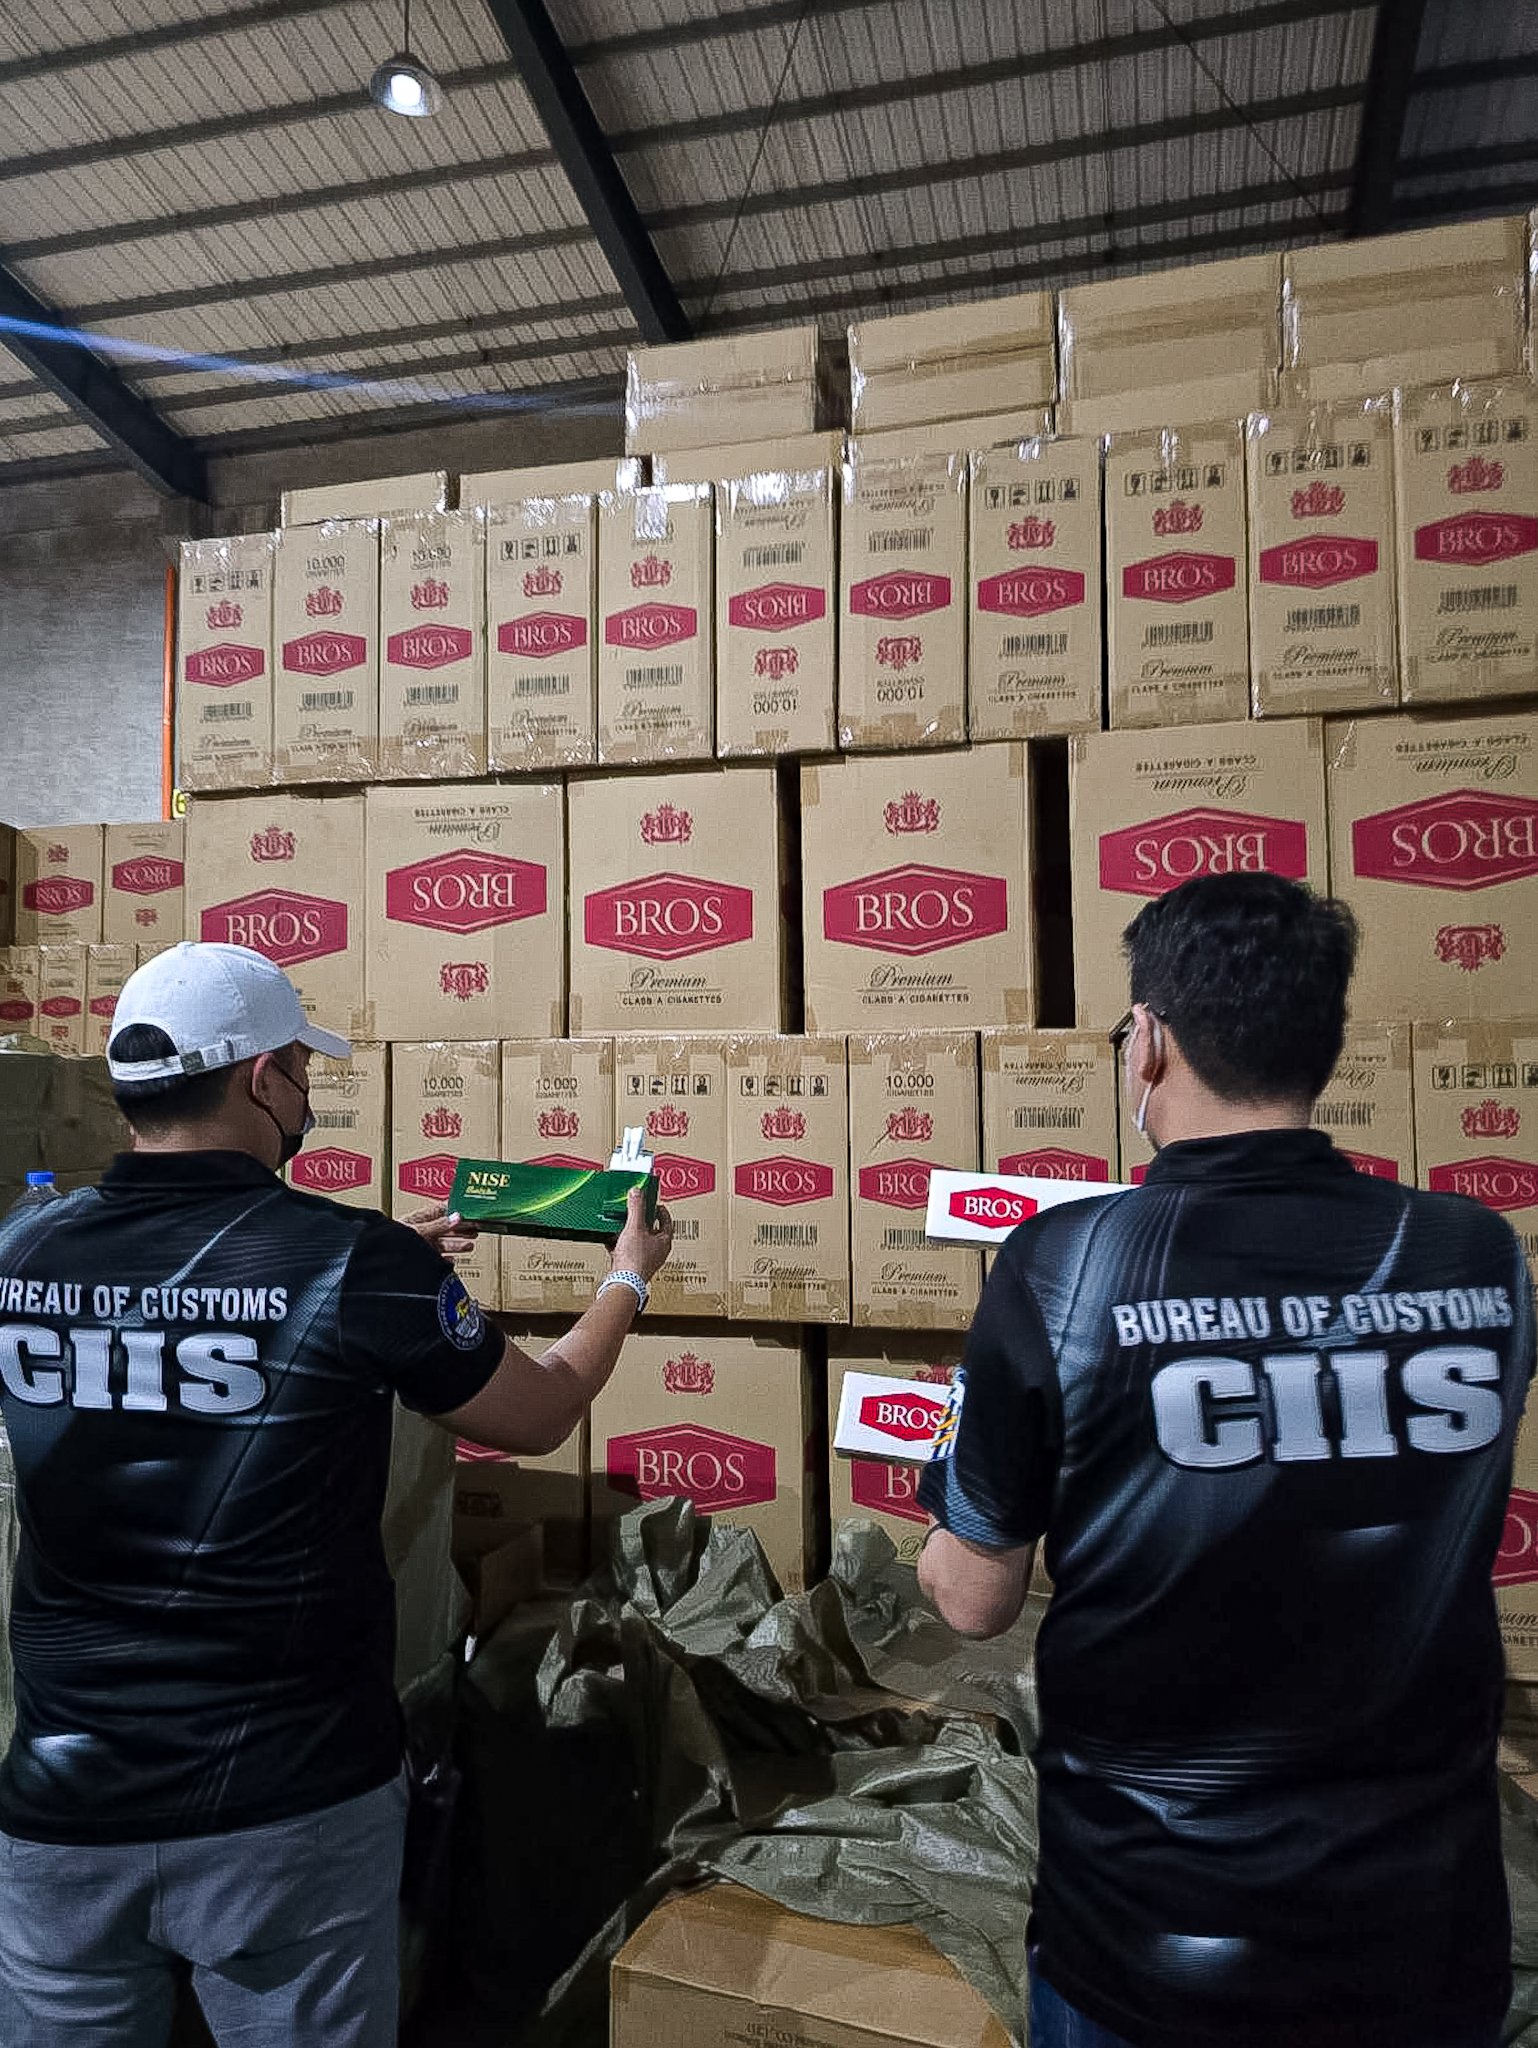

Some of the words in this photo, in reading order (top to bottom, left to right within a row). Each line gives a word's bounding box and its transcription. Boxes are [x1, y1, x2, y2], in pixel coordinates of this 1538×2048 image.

[1282, 550, 1358, 576] BROS
[1144, 563, 1216, 592] BROS
[866, 581, 932, 607] BROS
[999, 578, 1068, 605] BROS
[744, 596, 810, 622] BROS
[512, 625, 572, 650] BROS
[620, 615, 683, 639] BROS
[298, 642, 353, 667] BROS
[402, 632, 460, 659] BROS
[199, 653, 254, 677] BROS
[1152, 775, 1248, 798] Premium
[1392, 815, 1538, 867] BROS
[1134, 831, 1269, 882] BROS
[412, 872, 517, 913] BROS
[614, 896, 724, 937] BROS
[856, 887, 975, 932] BROS
[226, 910, 323, 948] BROS
[630, 967, 707, 988] Premium
[870, 963, 953, 987] Premium
[423, 1076, 464, 1090] 10.000
[536, 1077, 578, 1091] 10.000
[886, 1074, 935, 1089] 10.000
[304, 1159, 358, 1182] BROS
[413, 1166, 457, 1189] BRO
[468, 1171, 511, 1188] NISE
[653, 1166, 700, 1190] ROS
[752, 1167, 817, 1194] BROS
[877, 1172, 929, 1198] BRO
[1452, 1171, 1536, 1198] BROS
[963, 1196, 1024, 1220] BROS
[0, 1277, 82, 1316] UREAU
[93, 1285, 130, 1317] OF
[141, 1286, 288, 1322] CUSTOMS
[1112, 1296, 1271, 1348] BUREAU
[1280, 1296, 1332, 1339] OF
[1343, 1286, 1514, 1336] CUSTOMS
[0, 1323, 267, 1414] CIIS
[876, 1402, 942, 1431] BROS
[1151, 1344, 1501, 1468] CIIS
[634, 1448, 745, 1492] BROS
